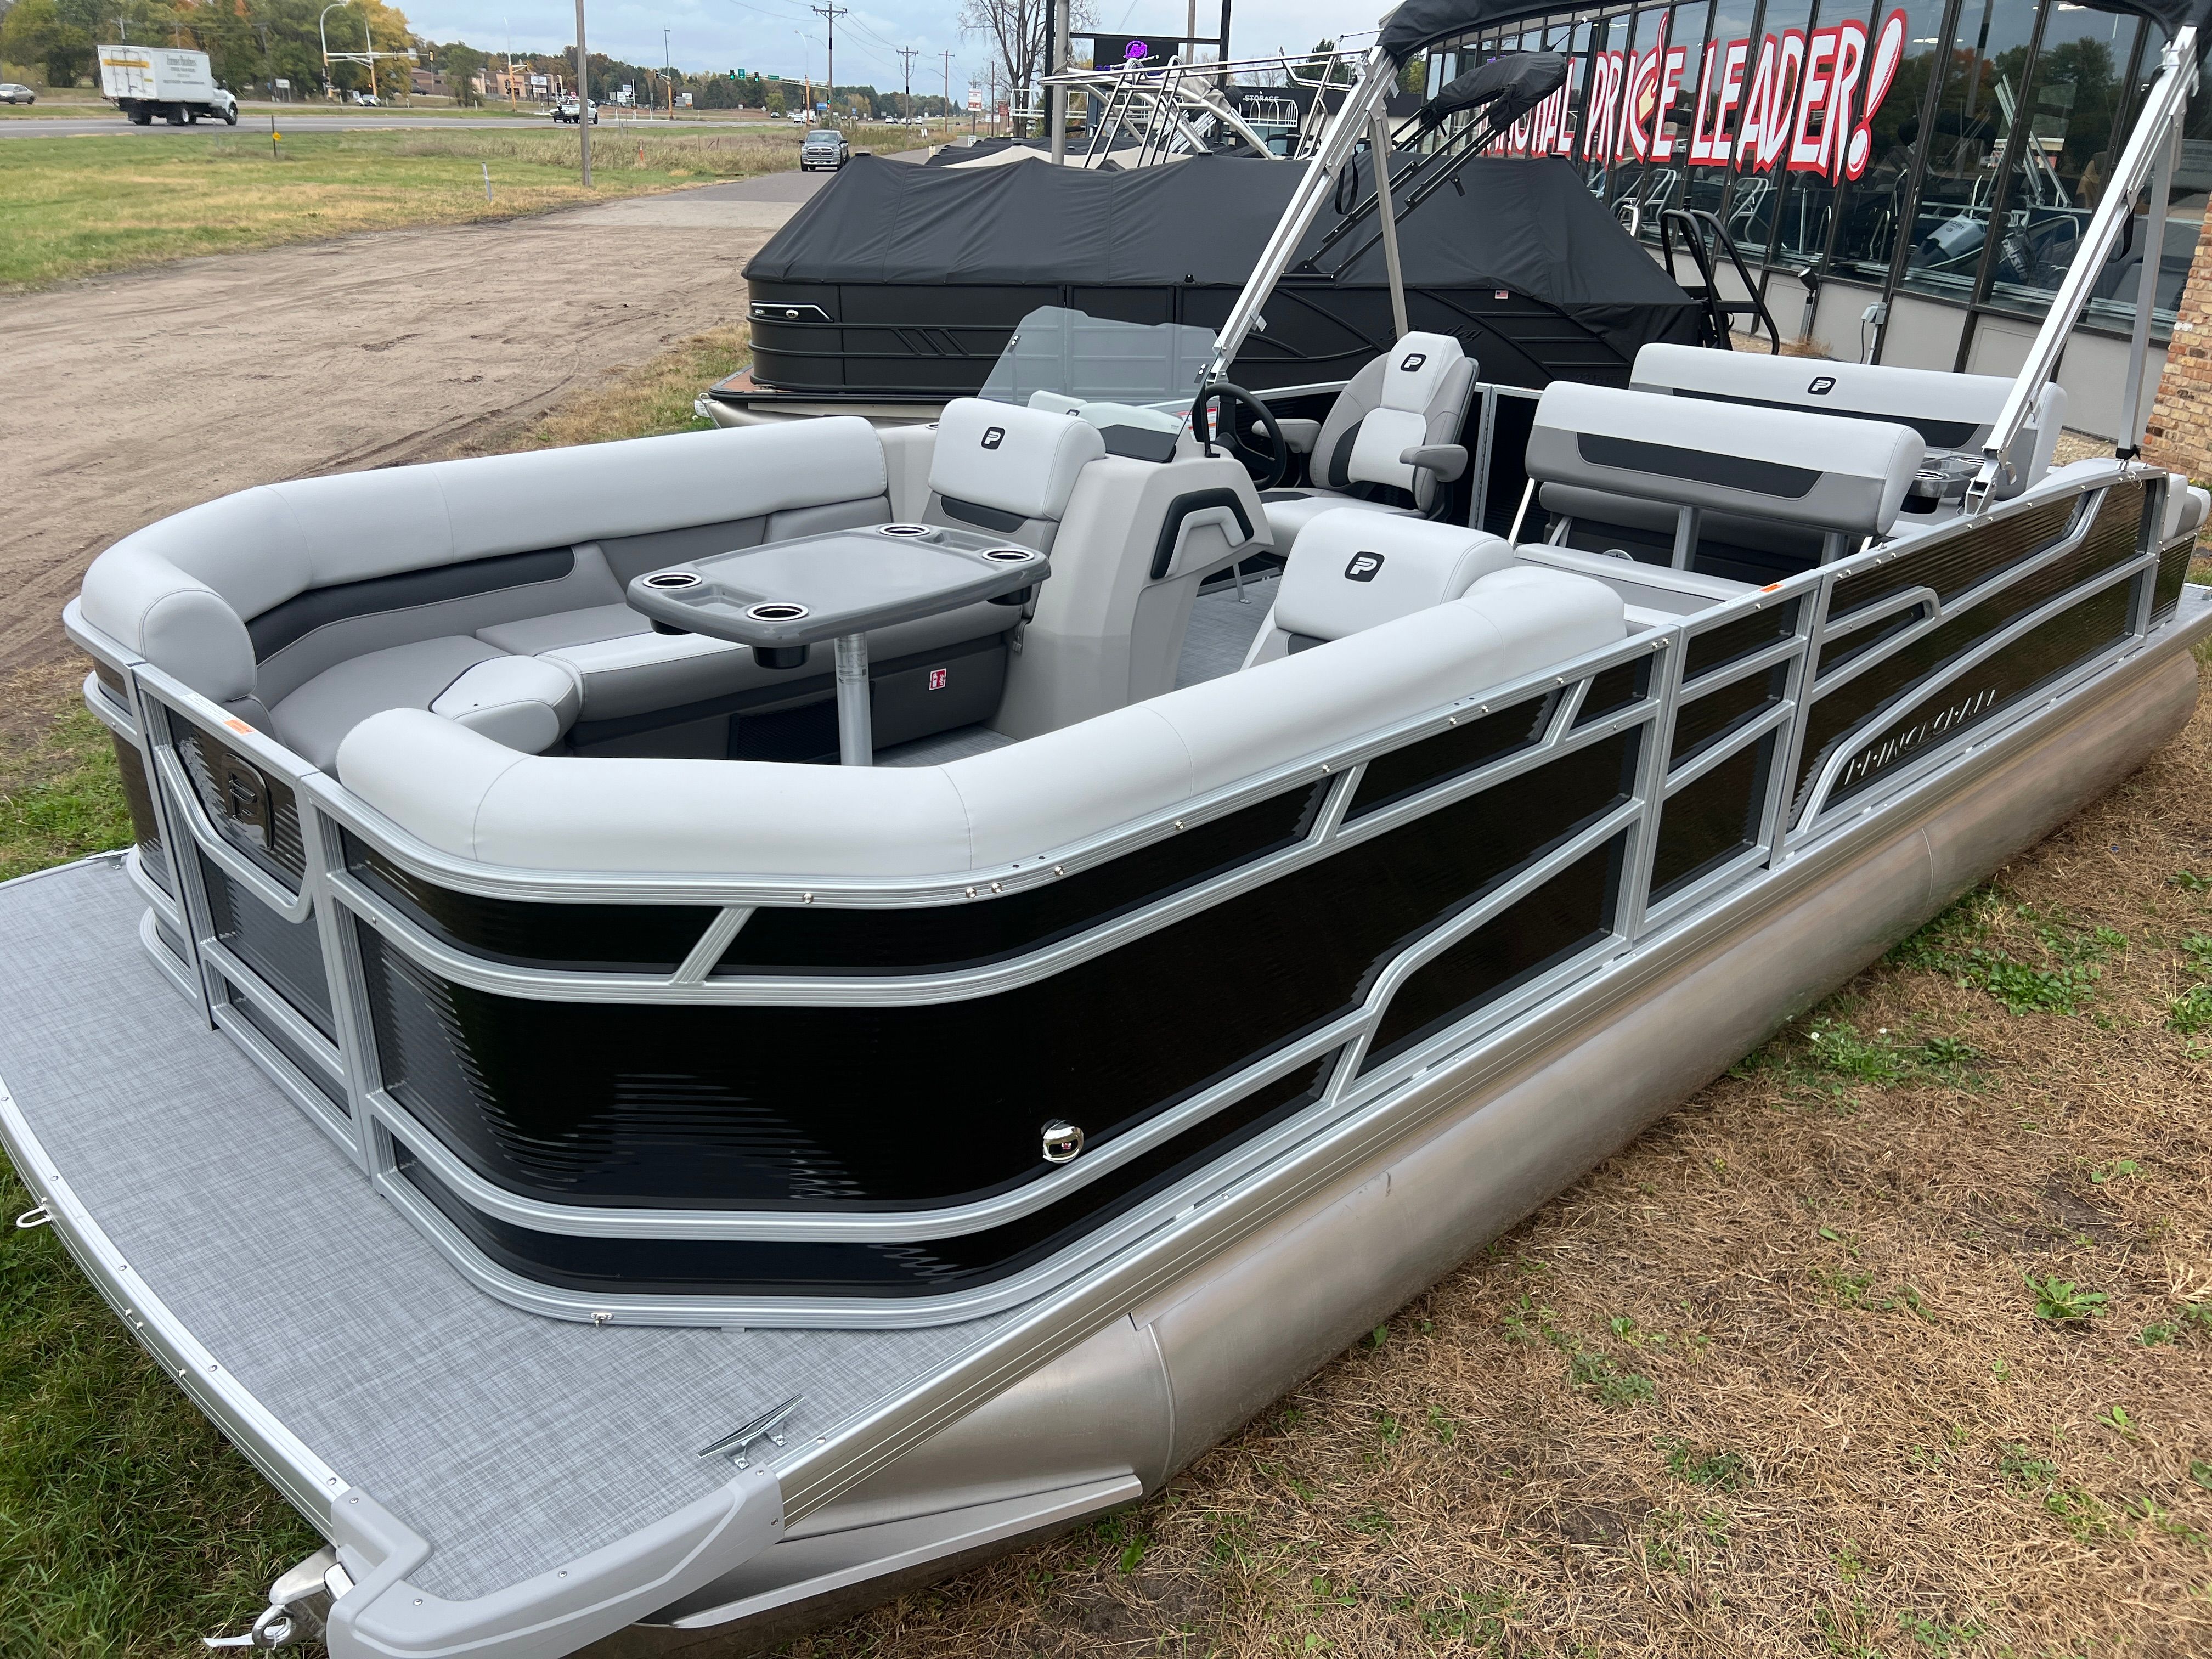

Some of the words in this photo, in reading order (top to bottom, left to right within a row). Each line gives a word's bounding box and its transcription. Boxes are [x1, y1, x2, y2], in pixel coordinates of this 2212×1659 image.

[1244, 94, 1279, 103] STORAGE
[1583, 33, 1688, 171] PRICE
[1688, 8, 1907, 187] LEADER!
